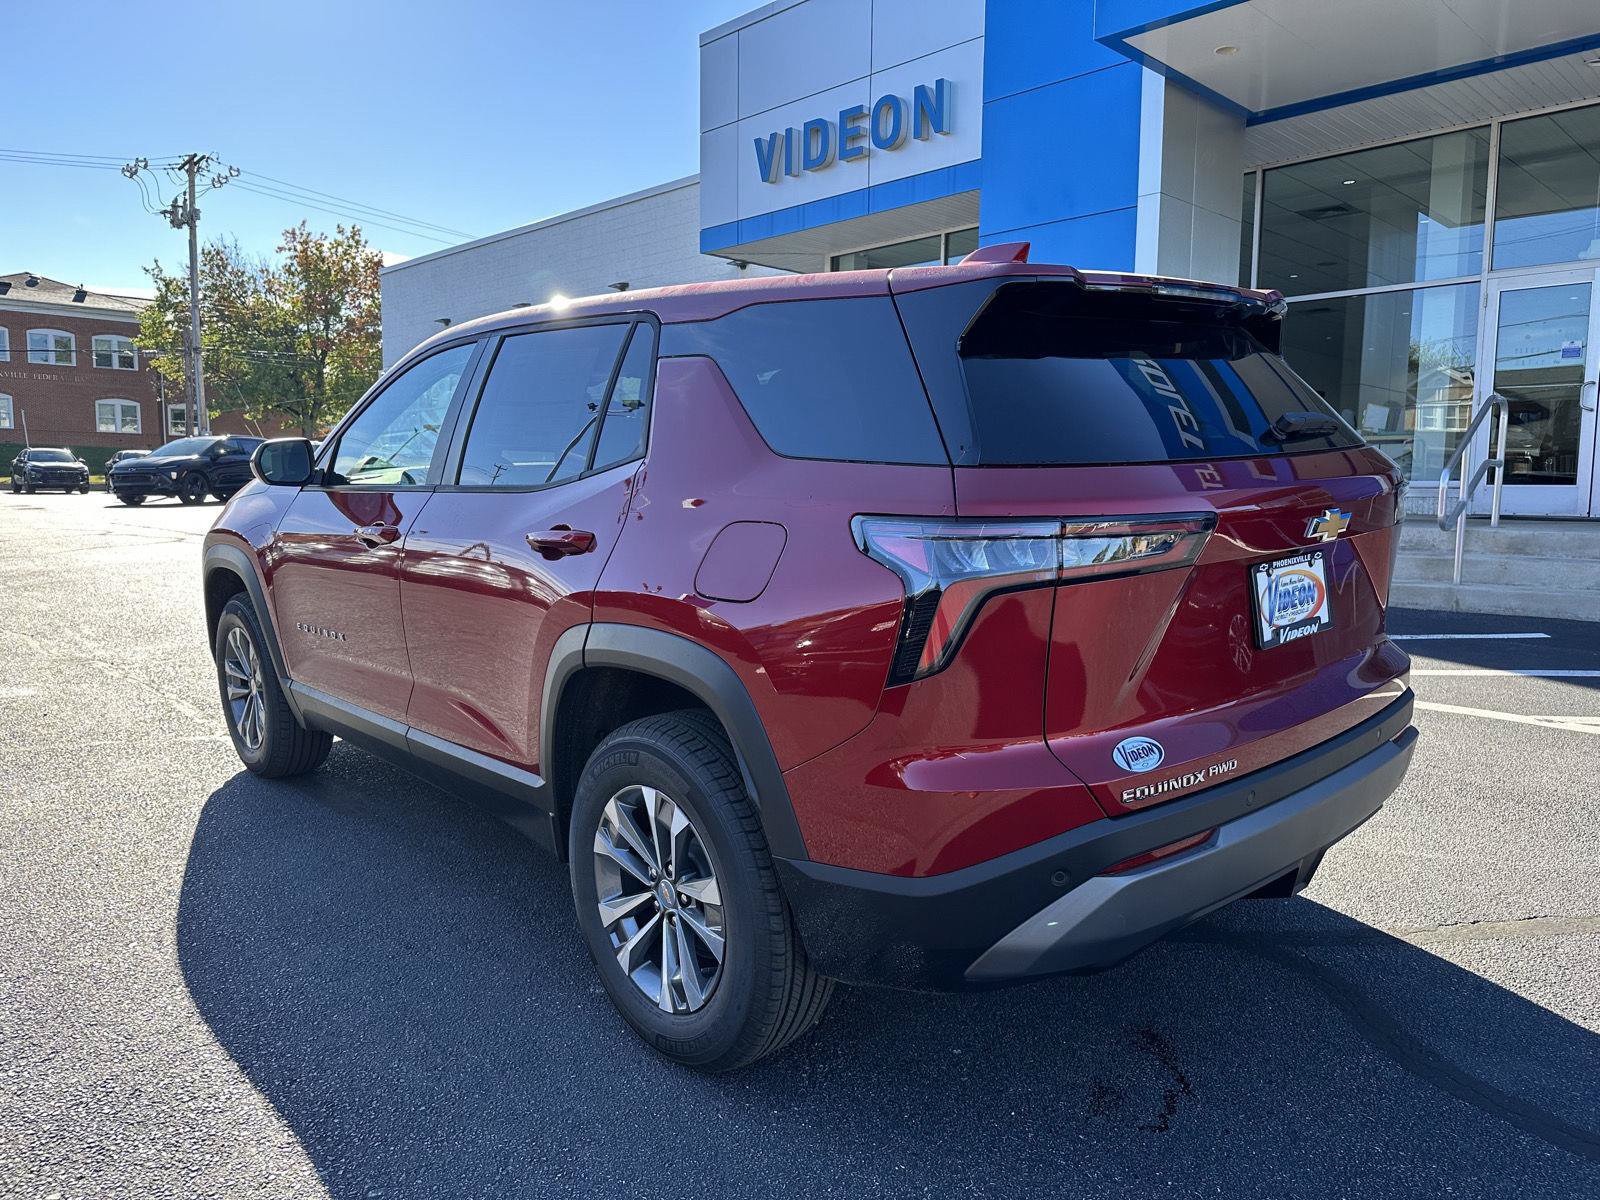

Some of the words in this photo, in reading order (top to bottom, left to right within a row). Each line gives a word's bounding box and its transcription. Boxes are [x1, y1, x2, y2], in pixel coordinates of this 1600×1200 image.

[754, 78, 951, 184] VIDEON
[1272, 554, 1311, 568] PHOENIXVILLE
[1268, 574, 1316, 627] VIDEON
[296, 622, 346, 641] EQUINOX
[1279, 620, 1319, 644] VIDEON
[1116, 743, 1157, 770] VIDEON
[1122, 770, 1205, 804] EQUINOX
[1209, 758, 1239, 777] AWD
